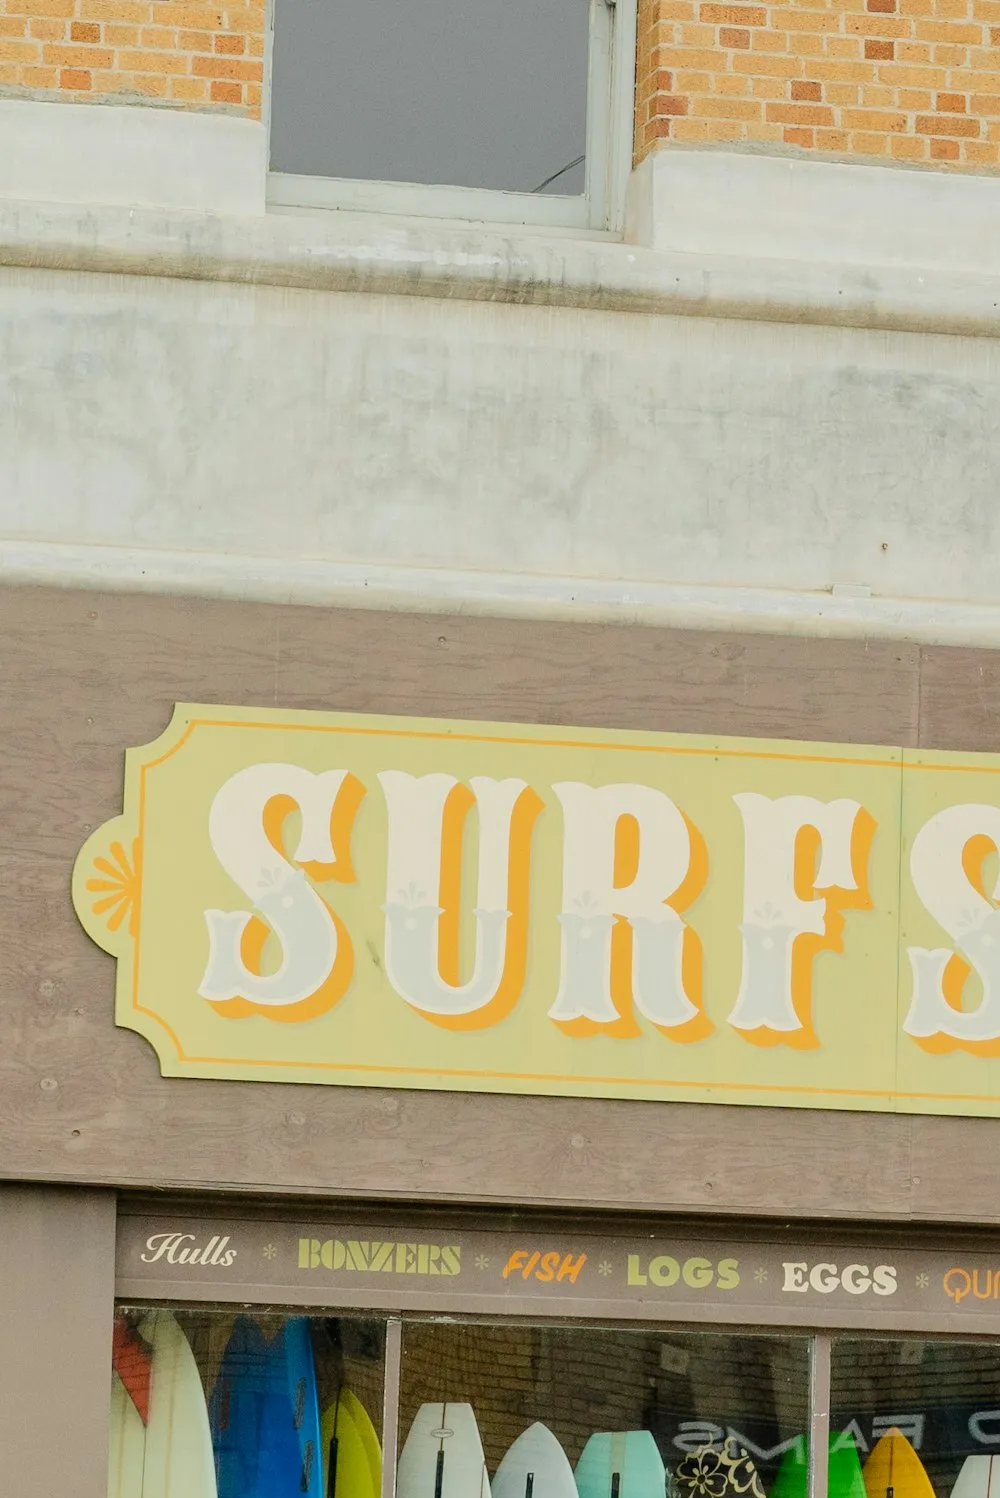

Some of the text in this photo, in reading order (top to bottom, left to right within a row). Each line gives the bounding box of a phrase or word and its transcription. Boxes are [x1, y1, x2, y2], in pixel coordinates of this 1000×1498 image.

[197, 762, 878, 1050] SURF
[141, 1232, 237, 1267] Hulls
[298, 1238, 461, 1276] BONZERS
[502, 1250, 587, 1284] FISH
[627, 1254, 740, 1290] LOGS
[782, 1262, 898, 1296] EGGS
